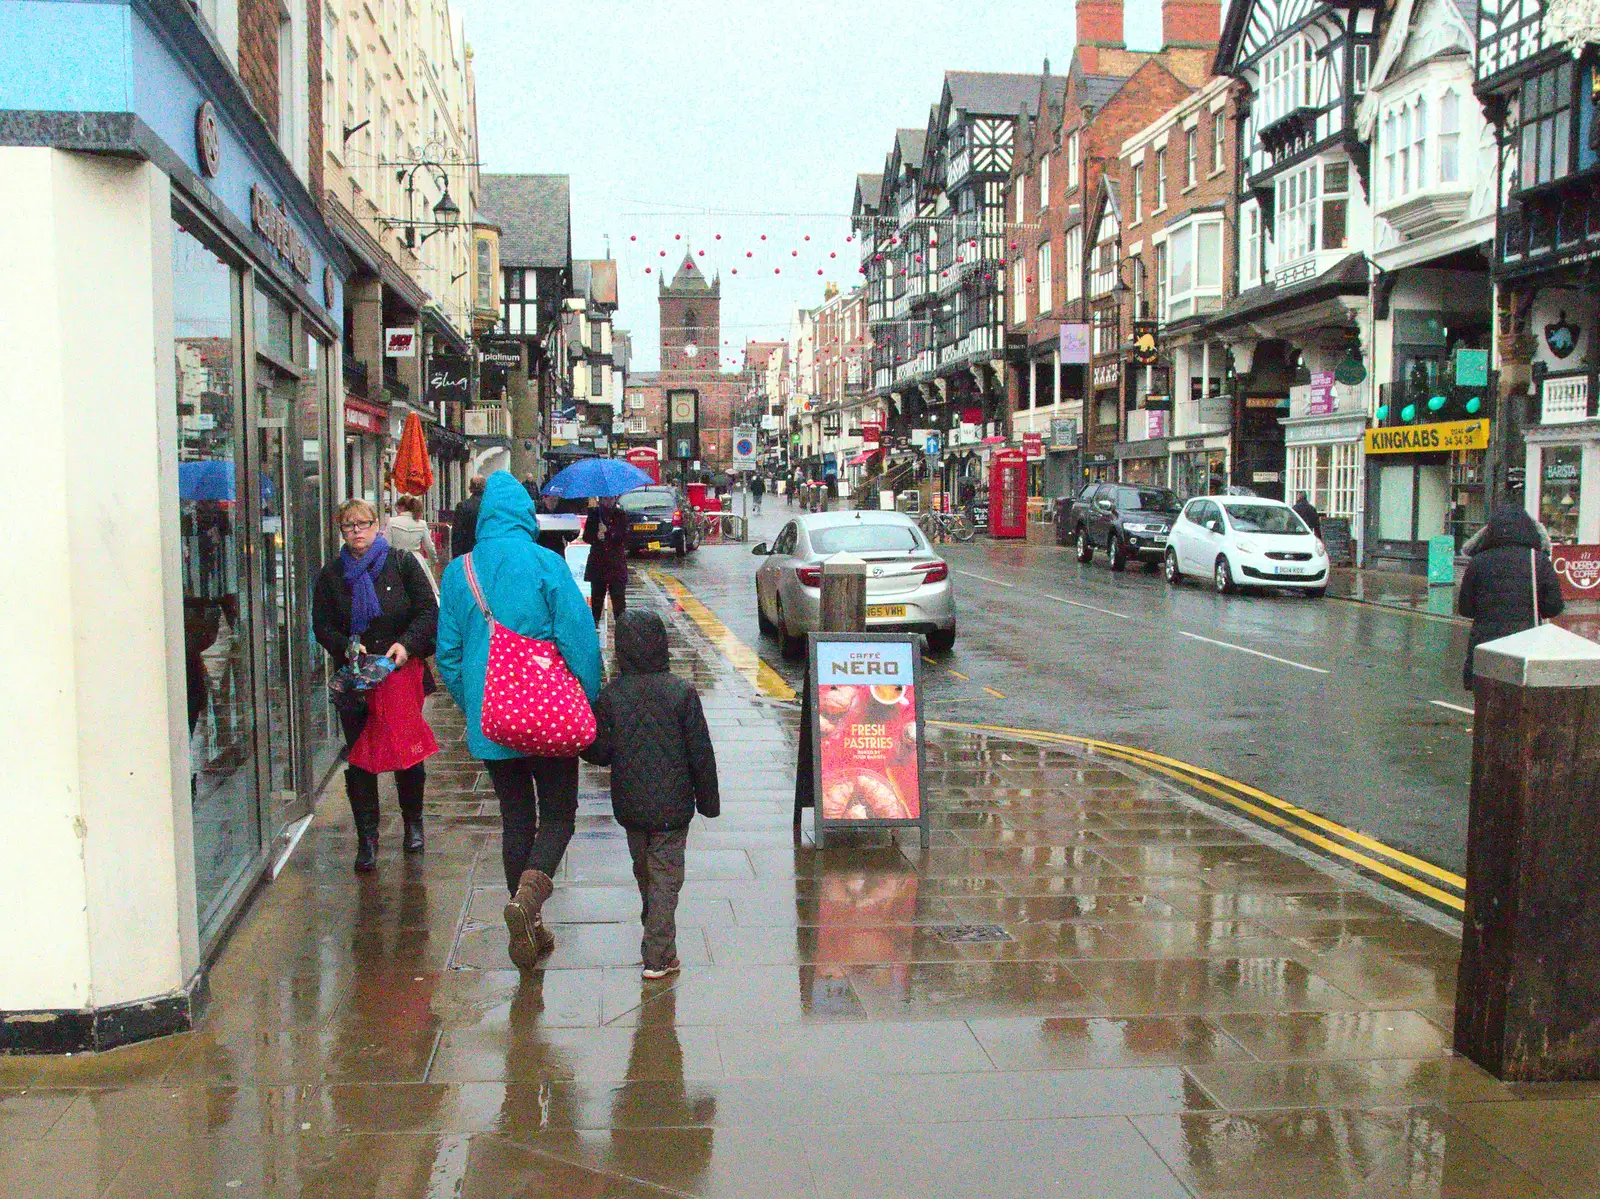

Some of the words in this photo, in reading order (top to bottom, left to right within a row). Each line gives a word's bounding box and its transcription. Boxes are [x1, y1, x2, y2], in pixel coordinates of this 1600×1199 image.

[484, 353, 520, 361] platinum
[1371, 429, 1439, 449] KINGKABS
[1454, 435, 1463, 446] 34
[1464, 435, 1473, 445] 34
[1548, 465, 1577, 478] BARISTA
[1573, 570, 1599, 578] COFFEE
[885, 606, 903, 616] VWH
[831, 661, 899, 676] NERO
[851, 723, 886, 736] FRESH
[844, 737, 894, 749] PASTRIES
